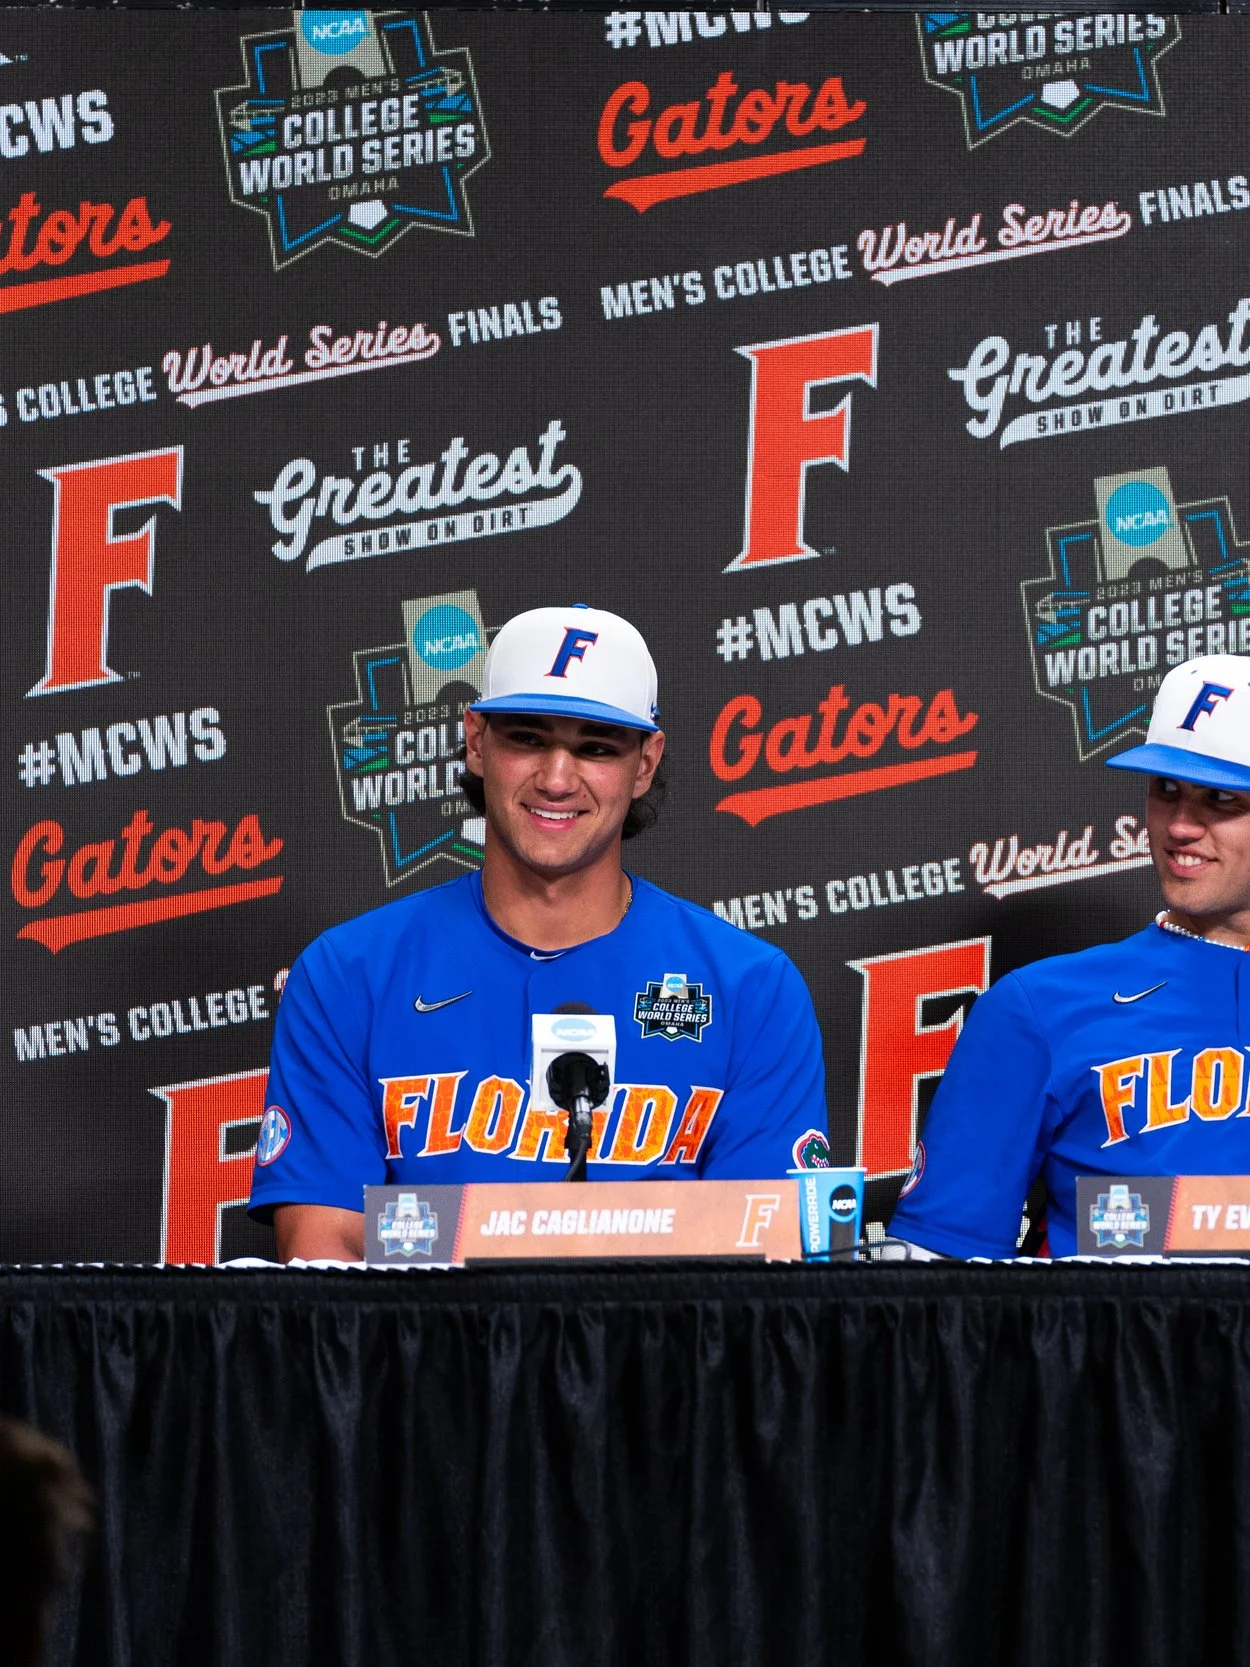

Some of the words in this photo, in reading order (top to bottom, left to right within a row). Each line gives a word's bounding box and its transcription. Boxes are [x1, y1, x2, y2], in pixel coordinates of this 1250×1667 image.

[311, 18, 366, 42] NCAA
[604, 12, 810, 48] #MC
[934, 25, 1047, 75] WORLD
[1054, 14, 1166, 55] SERIES
[291, 90, 340, 108] 2023
[345, 80, 400, 101] MEN'S
[1021, 57, 1092, 80] OMAHA
[282, 94, 420, 149] COLLEGE
[598, 71, 867, 167] Gators
[238, 144, 353, 196] WORLD
[361, 123, 477, 175] SERIES
[328, 179, 399, 200] OMAHA
[0, 191, 172, 274] tors
[601, 270, 706, 320] MEN'S
[713, 244, 853, 300] COLLEGE
[857, 213, 988, 272] World
[997, 198, 1133, 246] Series
[1044, 317, 1103, 343] THE
[16, 366, 157, 423] COLLEGE
[161, 334, 295, 393] World
[304, 319, 441, 368] Series
[447, 296, 564, 348] FINALS
[1037, 404, 1103, 435] SHOW
[1119, 397, 1148, 421] ON
[1164, 384, 1219, 411] DIRT
[351, 439, 411, 471] THE
[722, 321, 880, 574] F
[254, 420, 570, 562] Greatest
[344, 528, 412, 556] SHOW
[426, 519, 457, 542] ON
[473, 507, 530, 533] DIRT
[1115, 509, 1168, 532] NCAA
[24, 444, 184, 698] F
[1149, 569, 1203, 593] MEN'S
[715, 582, 923, 664] #MCWS
[1087, 584, 1222, 641] COLLEGE
[423, 632, 477, 657] NCAA
[543, 626, 598, 678] F
[1045, 635, 1157, 687] WORLD
[709, 684, 979, 781] Gators
[1176, 680, 1235, 732] F
[18, 707, 227, 789] #MCWS
[10, 809, 283, 908] Gators
[825, 858, 965, 915] COLLEGE
[969, 826, 1098, 885] World
[14, 1010, 120, 1061] MEN'S
[127, 984, 268, 1042] COLLEGE
[638, 1010, 672, 1021] WORLD
[673, 1012, 708, 1023] SERIES
[653, 1002, 694, 1013] COLLEGE
[378, 1069, 725, 1166] FLORDA
[480, 1210, 525, 1236] JAC
[531, 1208, 675, 1235] CAGLIANONE
[735, 1194, 781, 1248] F
[805, 1176, 821, 1254] POWERADE
[1191, 1204, 1222, 1230] TY
